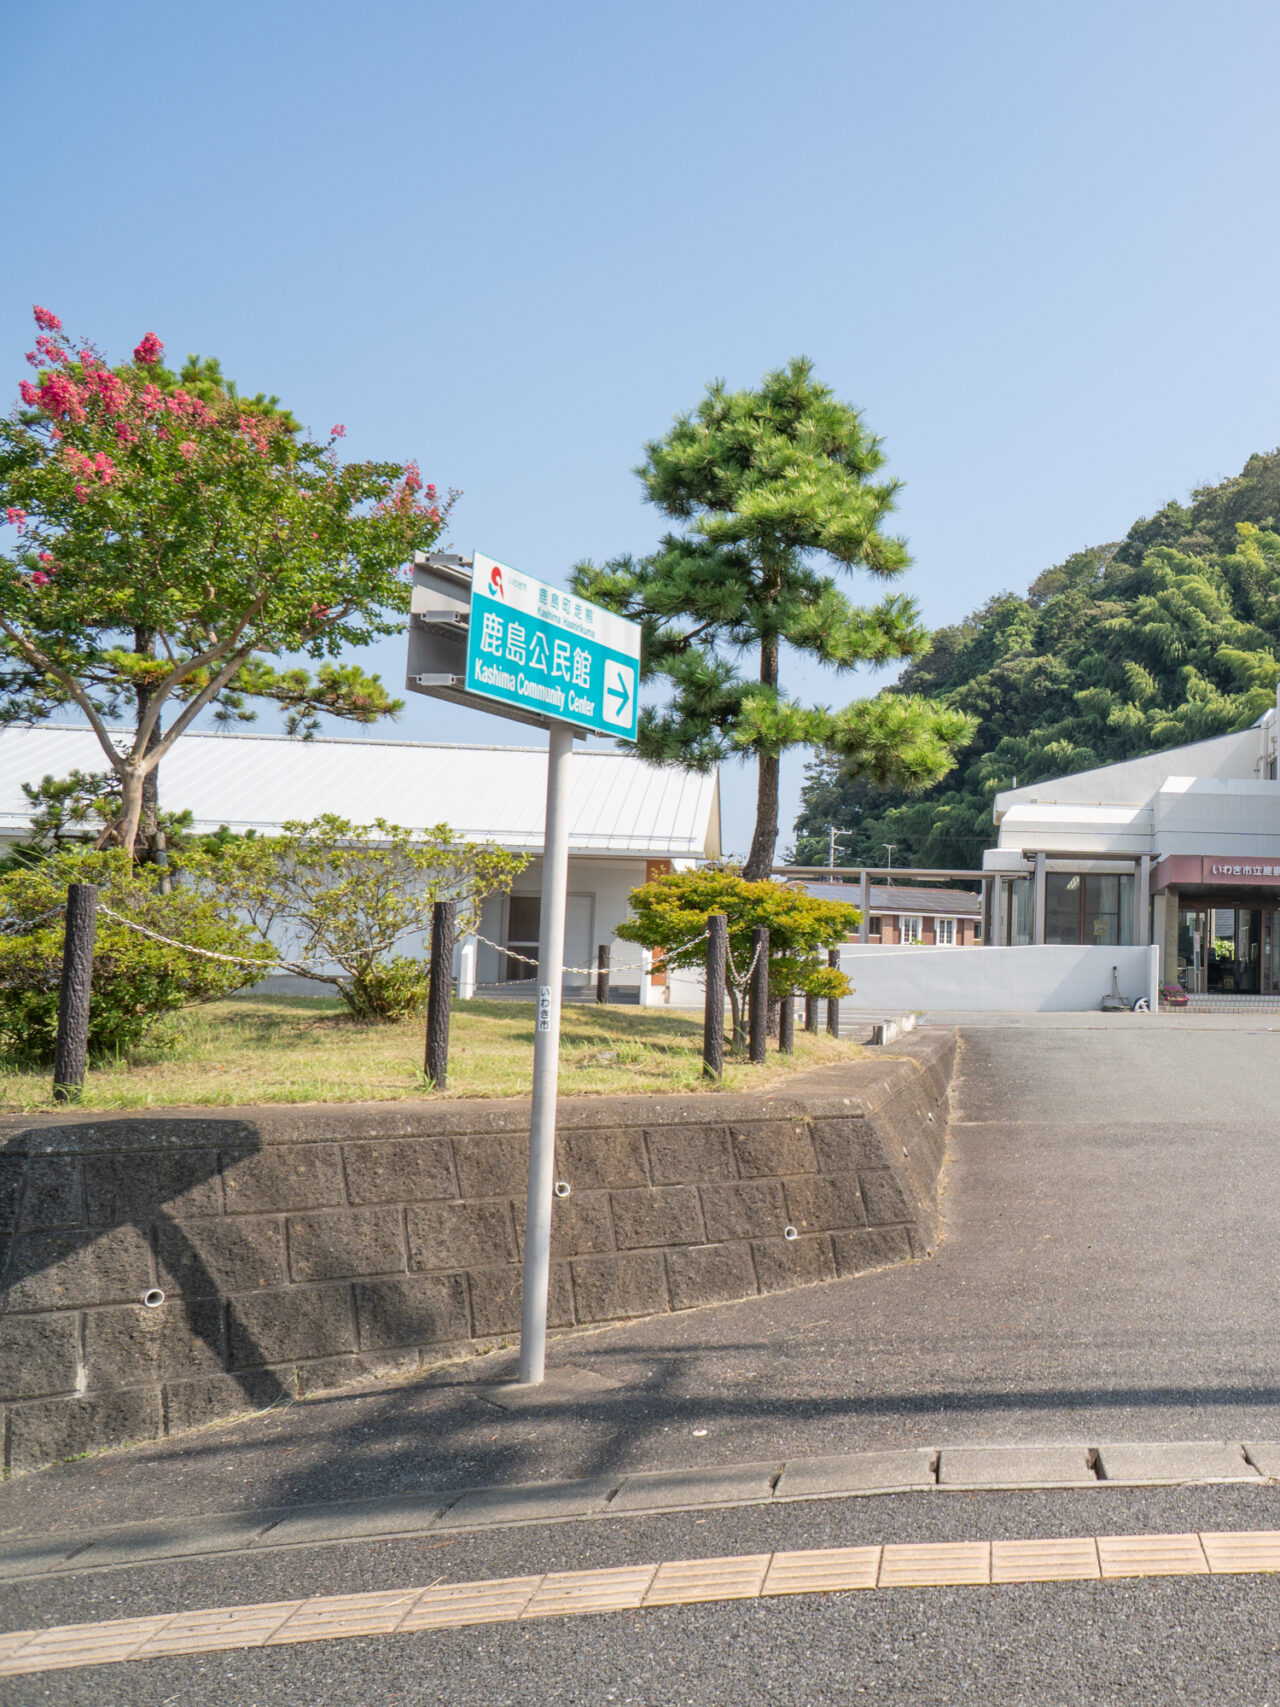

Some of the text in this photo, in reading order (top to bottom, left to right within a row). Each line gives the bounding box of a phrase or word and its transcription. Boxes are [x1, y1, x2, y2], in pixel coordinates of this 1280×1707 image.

[537, 606, 561, 624] Kashima
[480, 612, 592, 689] 鹿島公民館
[474, 657, 595, 718] Kashima Community Center
[540, 987, 550, 1030] いわき市
